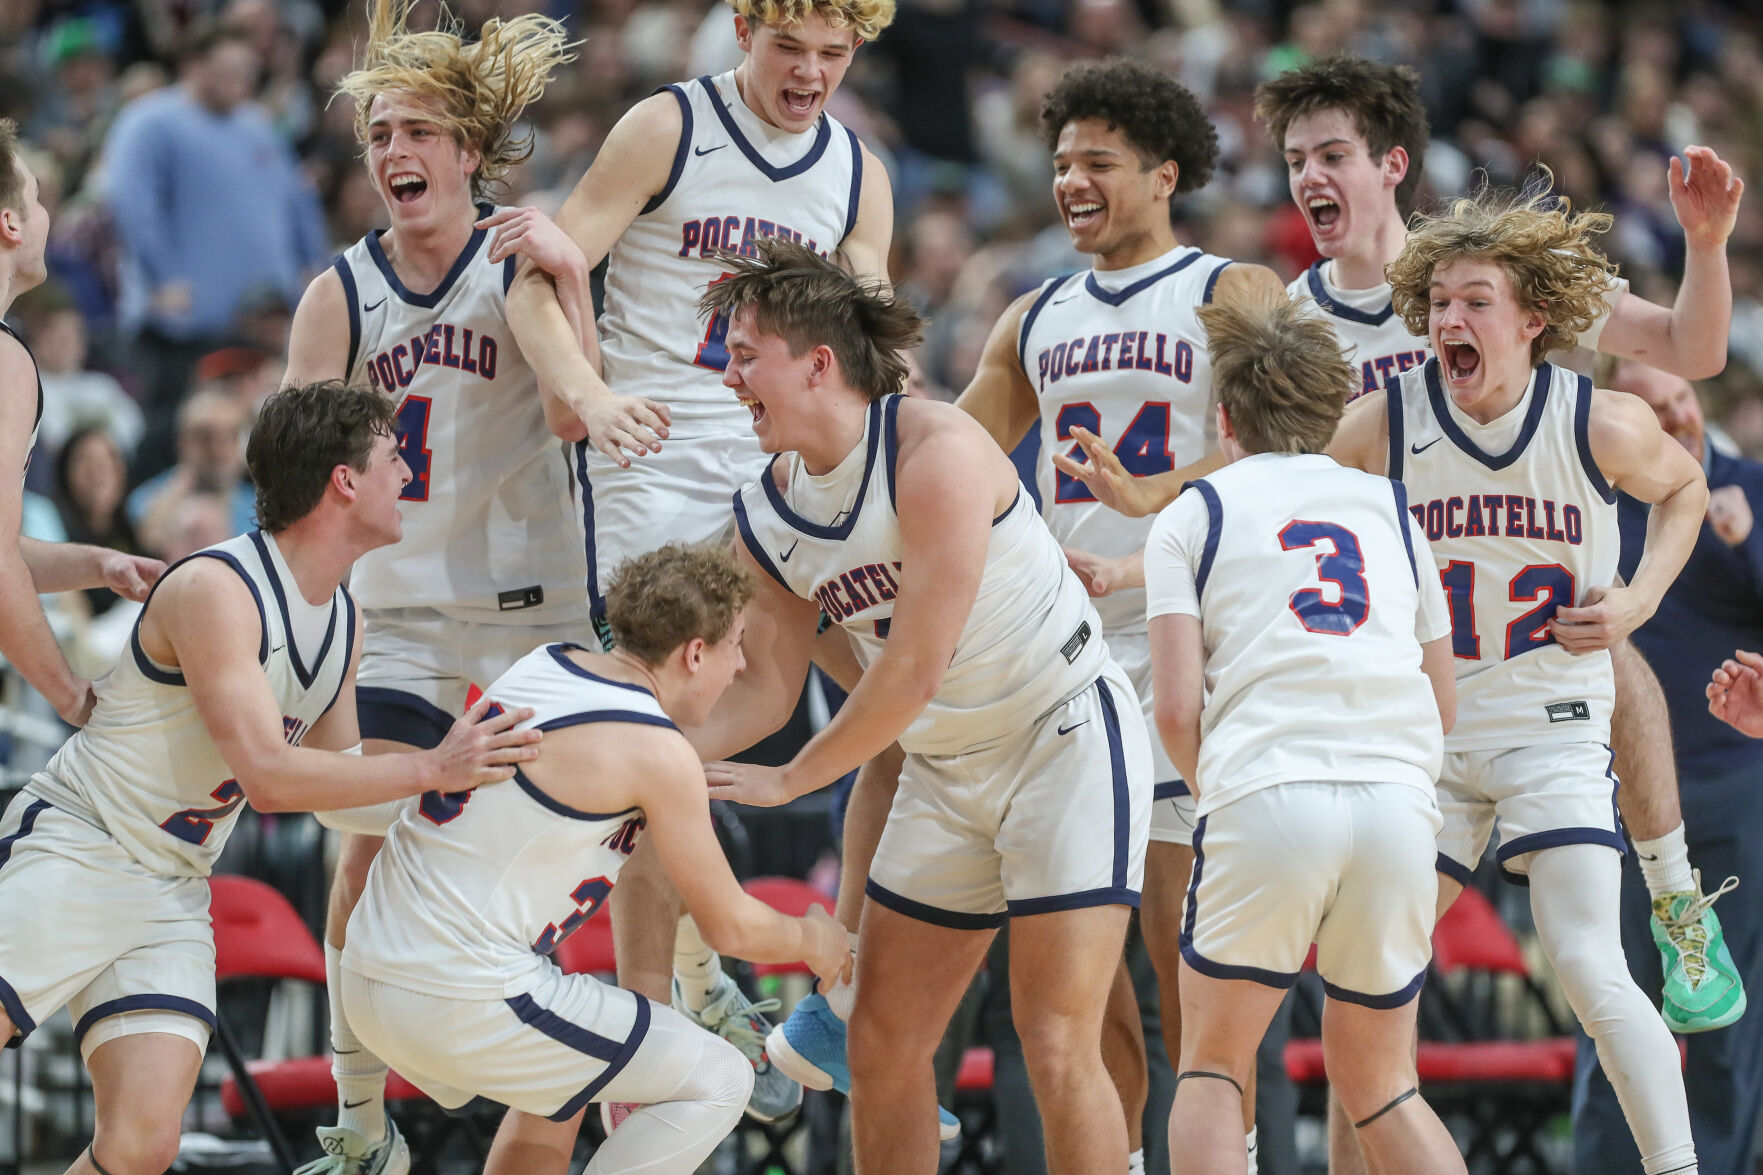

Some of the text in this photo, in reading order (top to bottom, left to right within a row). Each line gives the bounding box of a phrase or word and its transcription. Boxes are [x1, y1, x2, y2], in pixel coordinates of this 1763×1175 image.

[1039, 331, 1194, 394] POCATELLO
[1055, 401, 1175, 505] 24
[1277, 519, 1370, 637] 3
[1440, 560, 1575, 661] 12
[1575, 705, 1584, 714] M
[159, 778, 246, 846] 2
